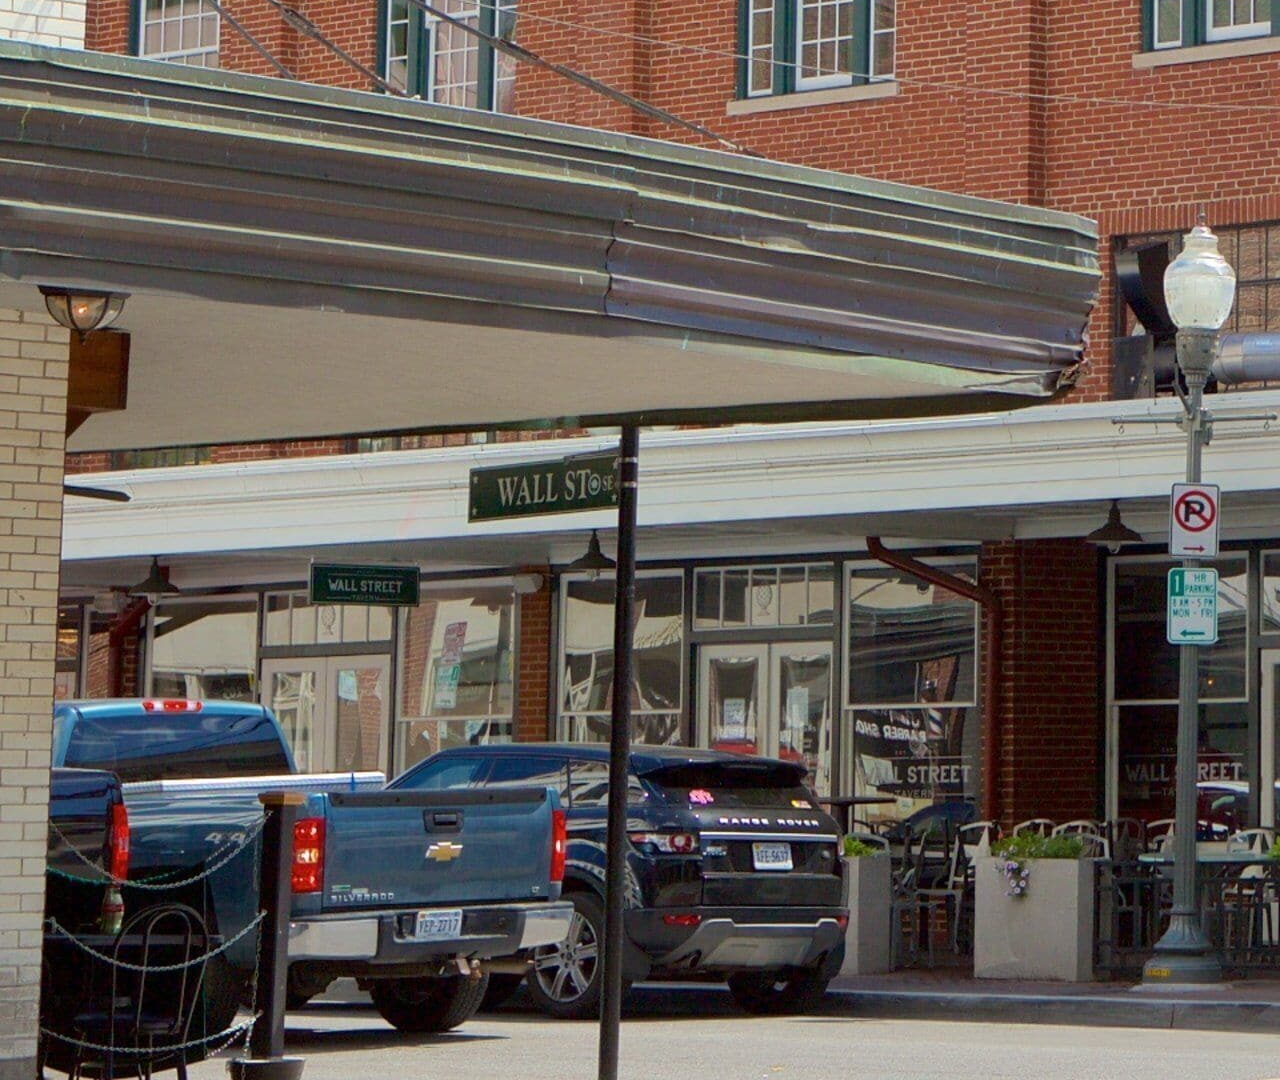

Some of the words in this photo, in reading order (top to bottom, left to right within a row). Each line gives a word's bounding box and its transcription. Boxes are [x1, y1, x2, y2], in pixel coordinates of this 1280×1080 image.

[497, 473, 558, 507] WALL
[564, 469, 591, 501] ST
[602, 475, 614, 491] SE
[328, 578, 358, 592] WALL
[360, 580, 403, 593] STREET
[1174, 575, 1180, 593] 1
[1194, 573, 1207, 582] HR
[1185, 584, 1215, 594] PARKING
[1179, 598, 1189, 607] AM
[1172, 608, 1190, 617] MON
[1201, 608, 1213, 618] FRI
[907, 765, 972, 783] STREET
[1125, 763, 1170, 782] WALL
[1175, 762, 1243, 780] REET
[719, 817, 769, 825] RANGE
[777, 818, 820, 826] ROVER
[331, 892, 394, 902] SILVERADO
